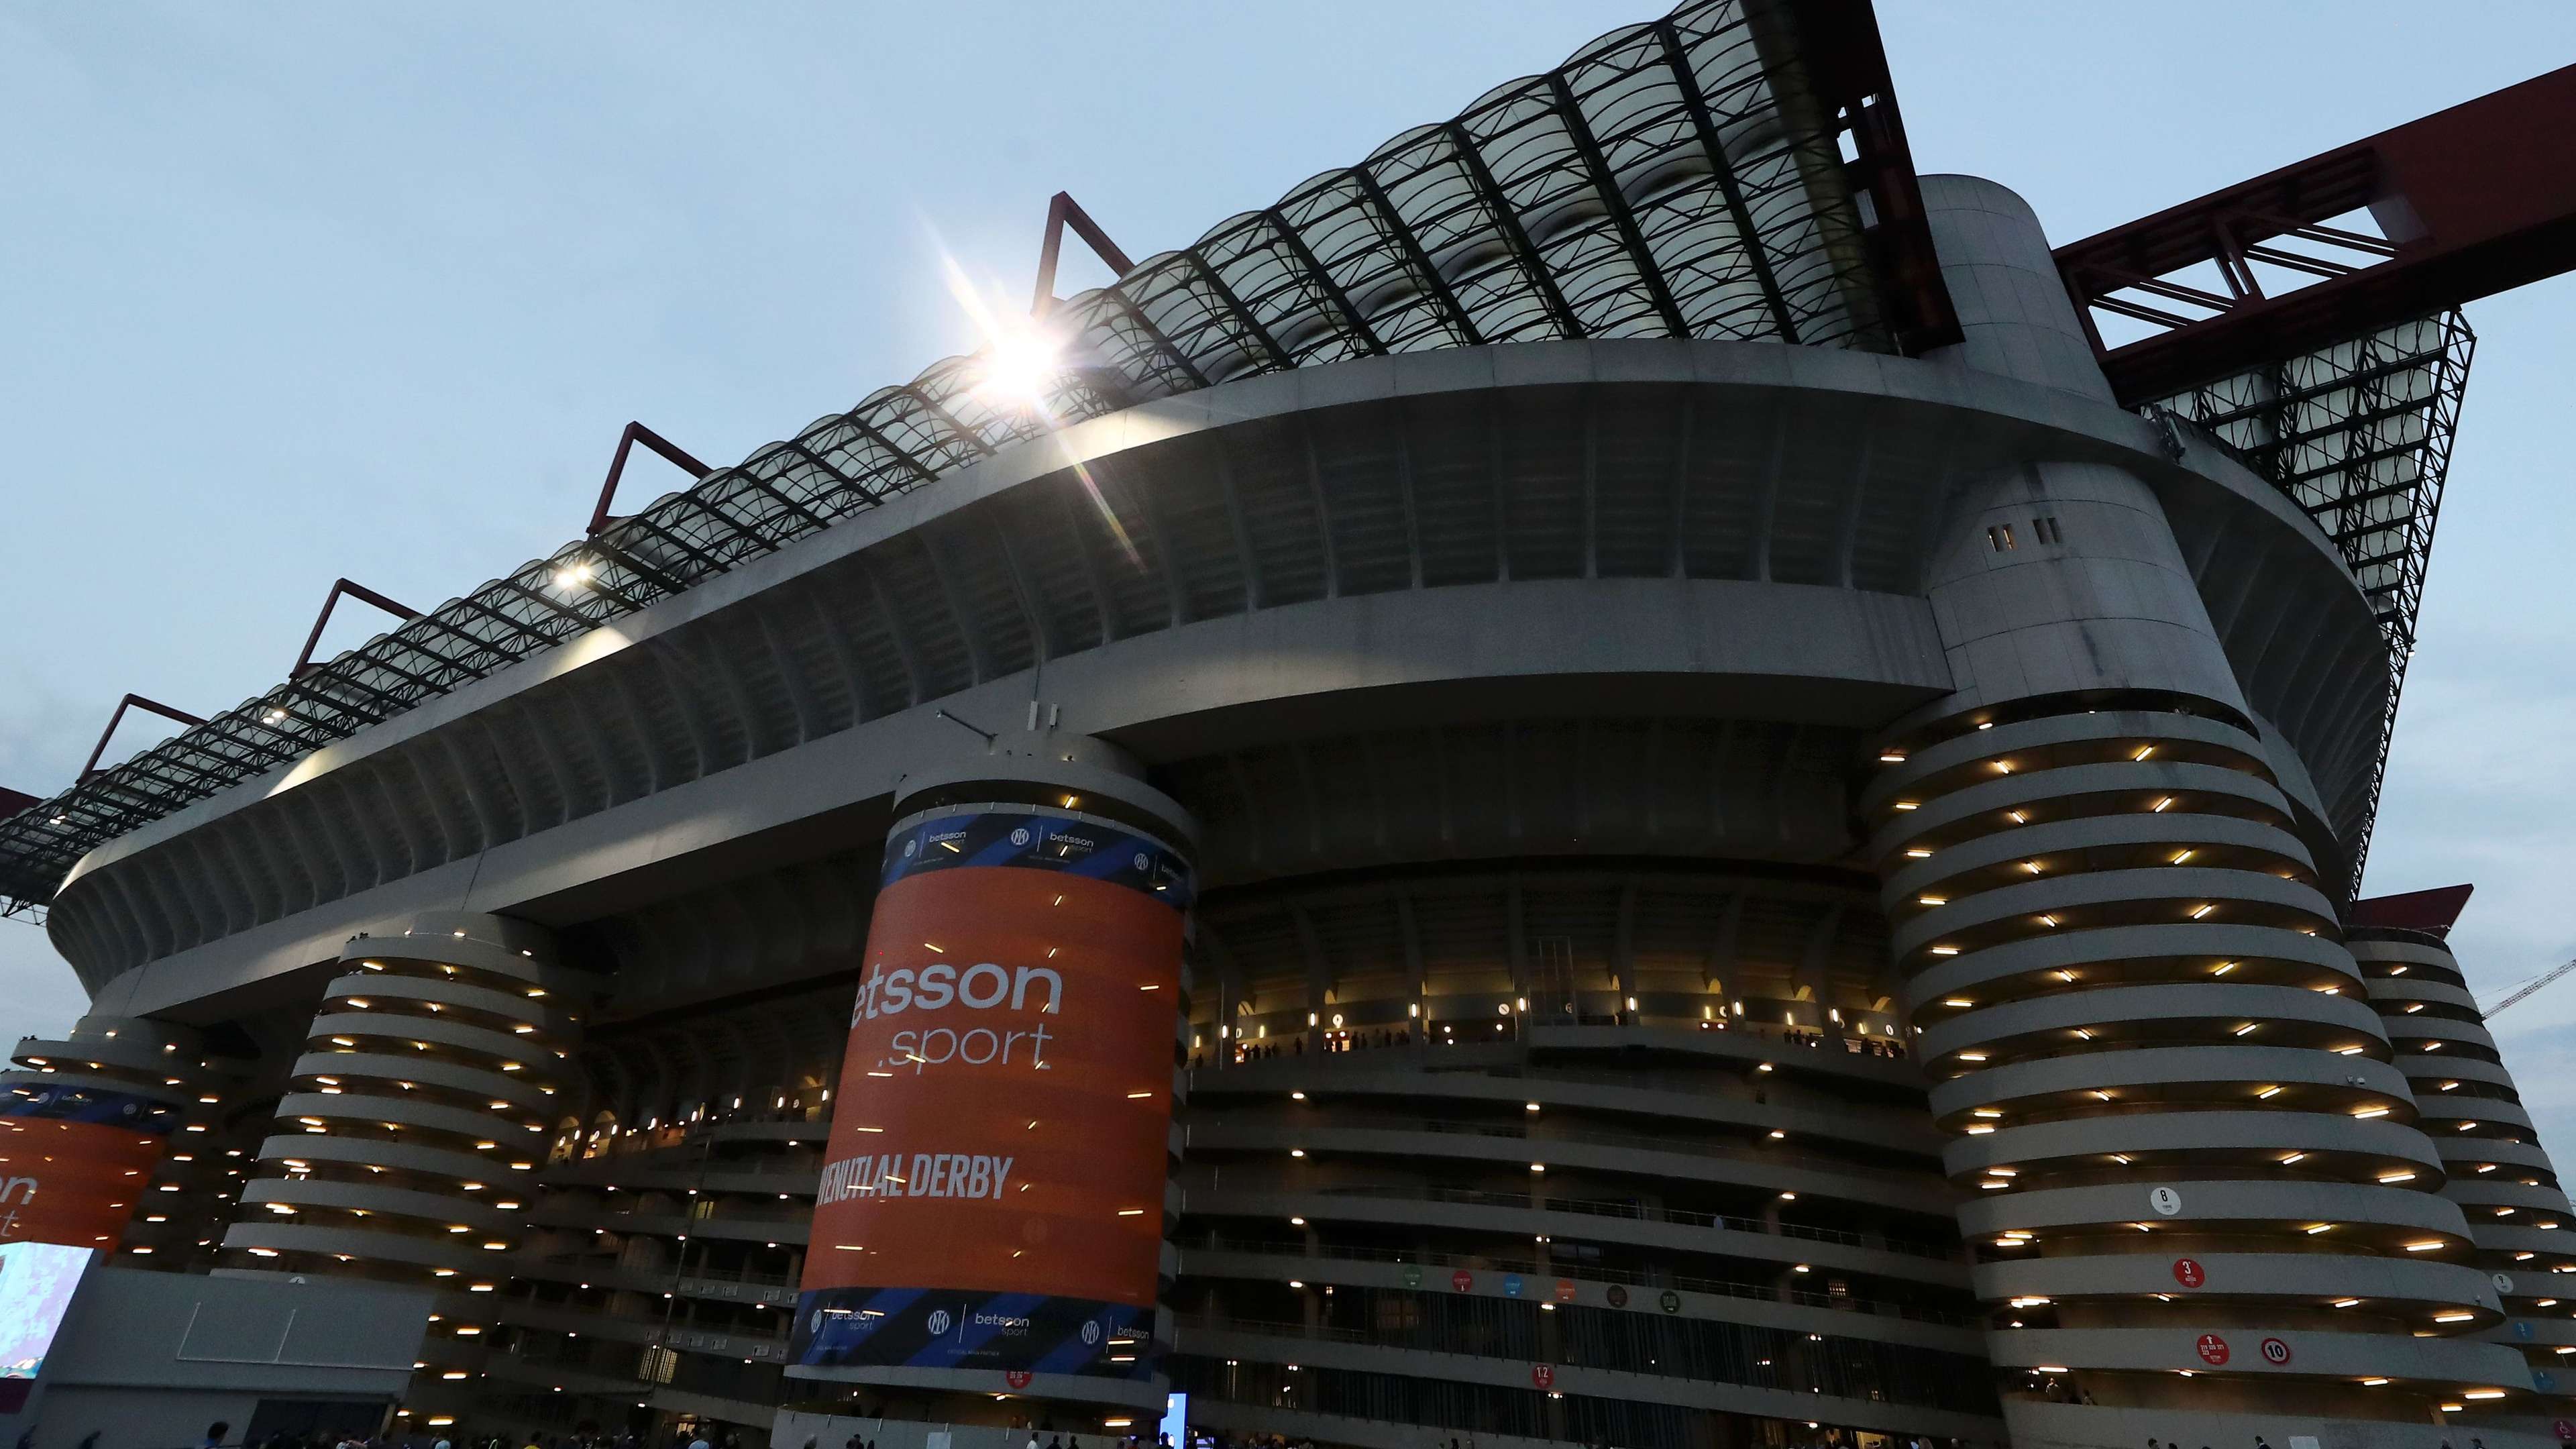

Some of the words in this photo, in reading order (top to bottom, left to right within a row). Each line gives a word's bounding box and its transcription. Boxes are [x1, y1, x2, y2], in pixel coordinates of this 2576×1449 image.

[928, 830, 966, 843] betsson
[1049, 832, 1094, 847] betsson
[869, 1154, 903, 1197] AL
[908, 1153, 1013, 1199] DERBY
[0, 1175, 38, 1205] n
[2160, 1189, 2168, 1201] 8
[849, 1321, 875, 1331] sport
[975, 1313, 1030, 1328] betsson
[1002, 1327, 1028, 1336] sport
[1117, 1325, 1149, 1339] betsson
[2268, 1344, 2282, 1358] 10
